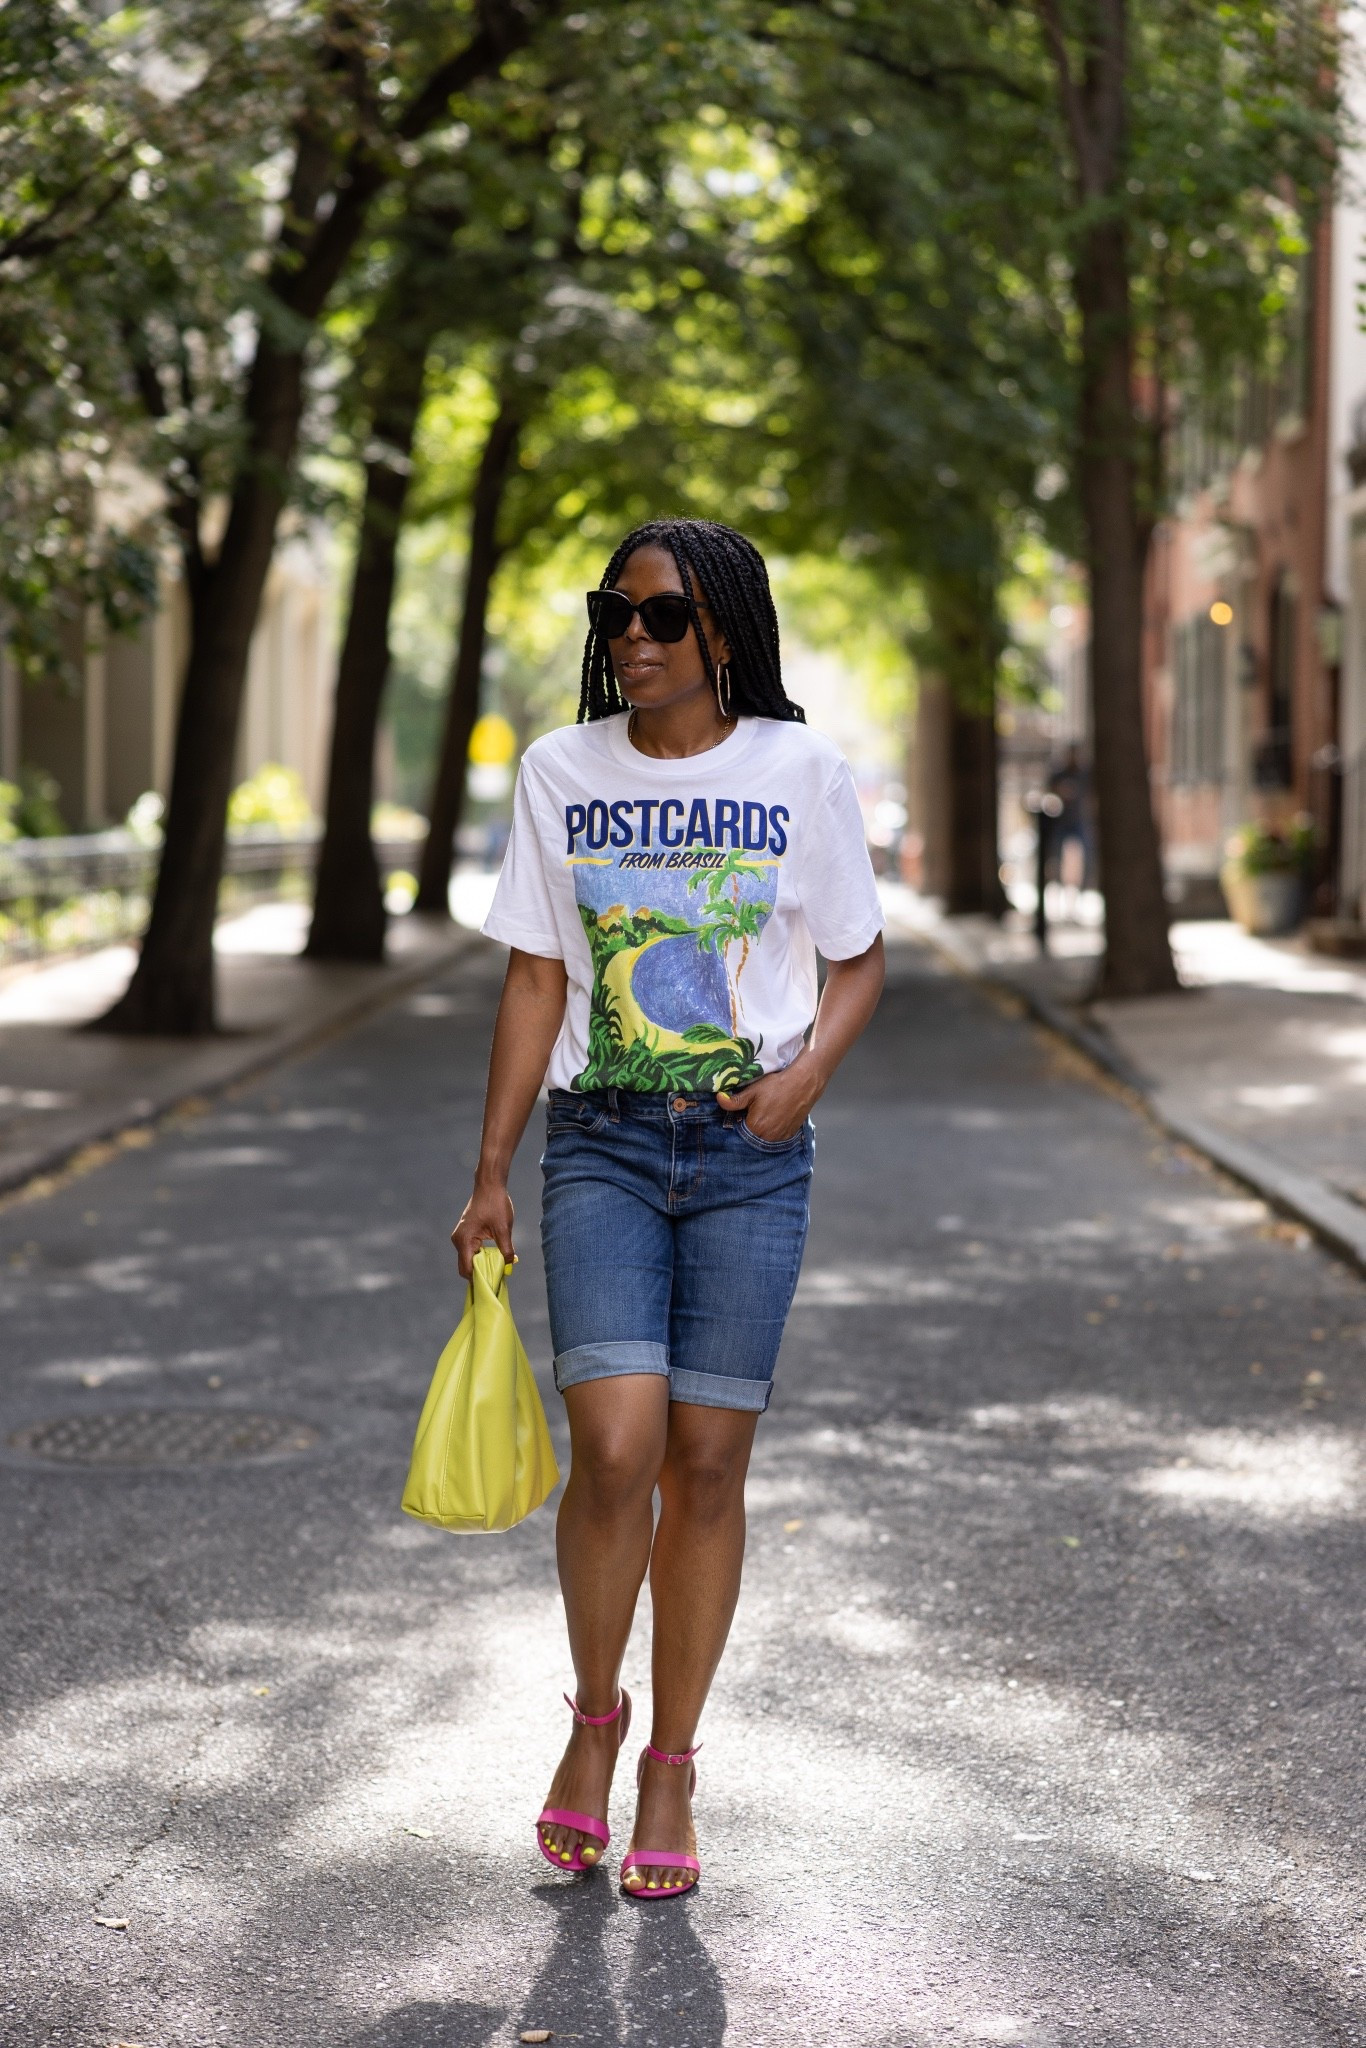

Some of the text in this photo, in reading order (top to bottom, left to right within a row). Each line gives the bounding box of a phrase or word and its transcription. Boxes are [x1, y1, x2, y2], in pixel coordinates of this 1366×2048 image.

[566, 799, 790, 857] POSTCARDS
[618, 852, 727, 868] FROM BRASIL
